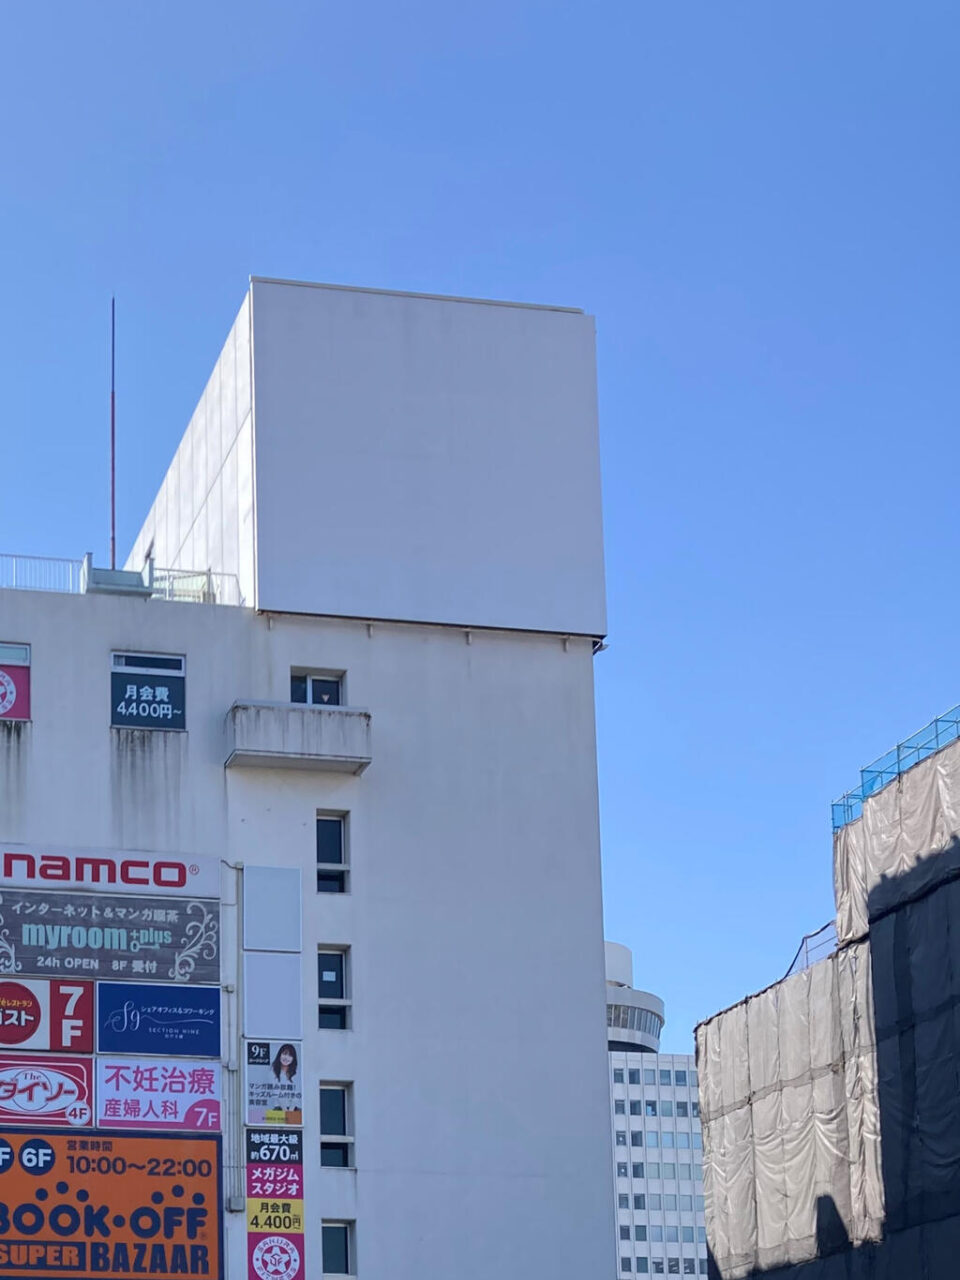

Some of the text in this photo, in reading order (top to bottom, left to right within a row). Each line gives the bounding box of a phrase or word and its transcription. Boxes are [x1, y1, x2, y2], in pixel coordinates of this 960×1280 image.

[125, 685, 169, 701] 月会費
[3, 853, 187, 888] namco
[22, 922, 127, 951] myroom
[36, 956, 158, 973] 24h OPEN 8F 受付
[251, 1044, 267, 1058] 9F
[104, 1066, 216, 1095] 不妊治療
[68, 1107, 88, 1119] 4F
[103, 1099, 179, 1119] 産婦人科
[194, 1107, 218, 1127] 7F
[66, 1140, 113, 1152] 営業時間
[250, 1133, 299, 1145] 地域最大級
[21, 1148, 52, 1168] 6F
[251, 1167, 299, 1181] メガジム
[251, 1182, 299, 1195] スタジオ
[259, 1202, 291, 1214] 月会費
[91, 1242, 209, 1275] BAZAAR
